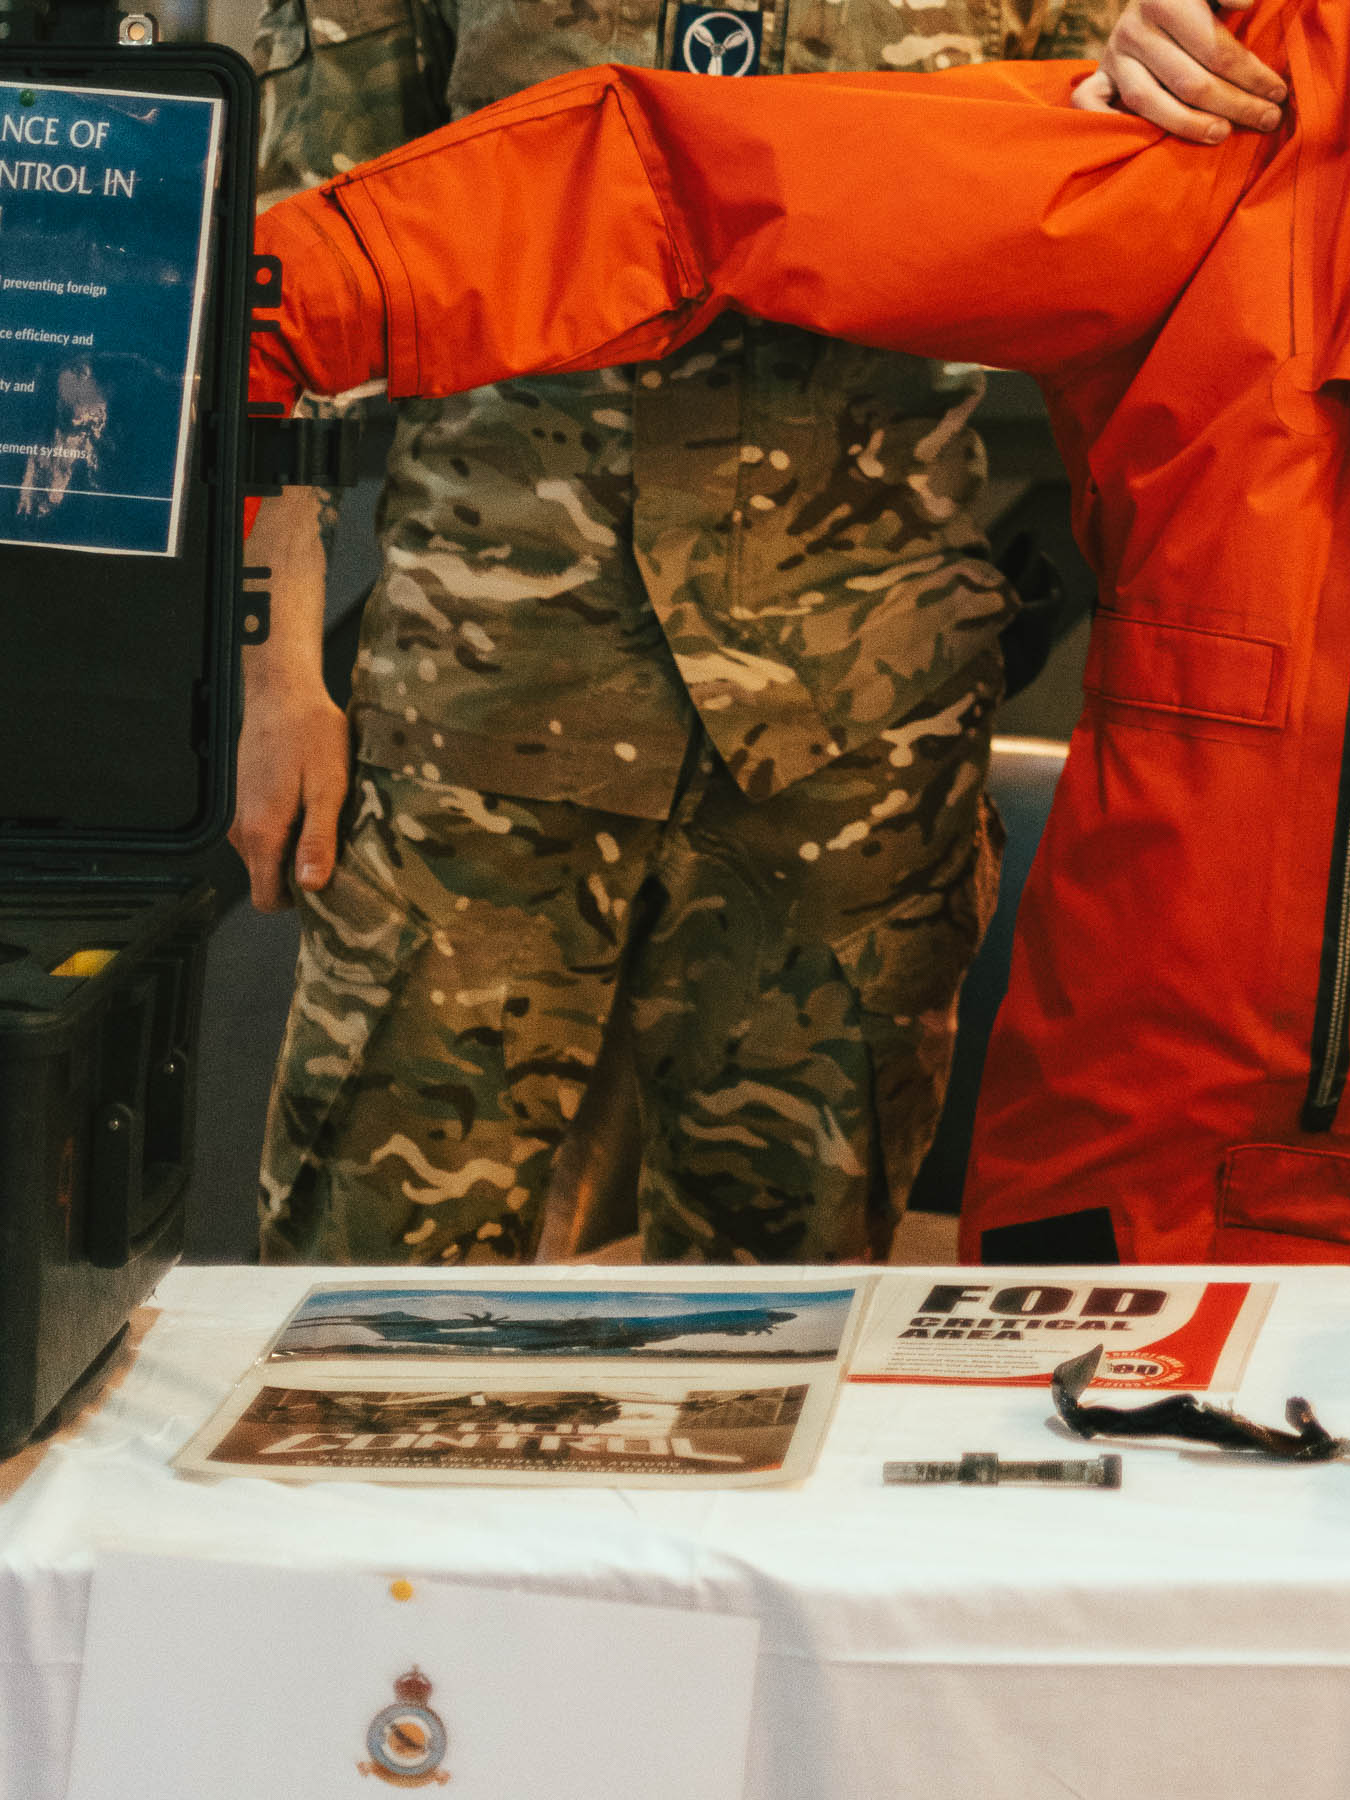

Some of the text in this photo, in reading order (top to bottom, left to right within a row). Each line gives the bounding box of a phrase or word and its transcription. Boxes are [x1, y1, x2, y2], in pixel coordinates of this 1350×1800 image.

[69, 119, 110, 149] OF
[103, 167, 136, 199] IN
[3, 278, 107, 298] preventing foreign
[15, 328, 70, 346] efficiency
[72, 332, 94, 346] and
[14, 380, 35, 393] and
[918, 1284, 1169, 1317] FOD
[897, 1328, 1023, 1340] AREA
[909, 1317, 1133, 1331] CRITICAL
[258, 1433, 746, 1464] CONTROL
